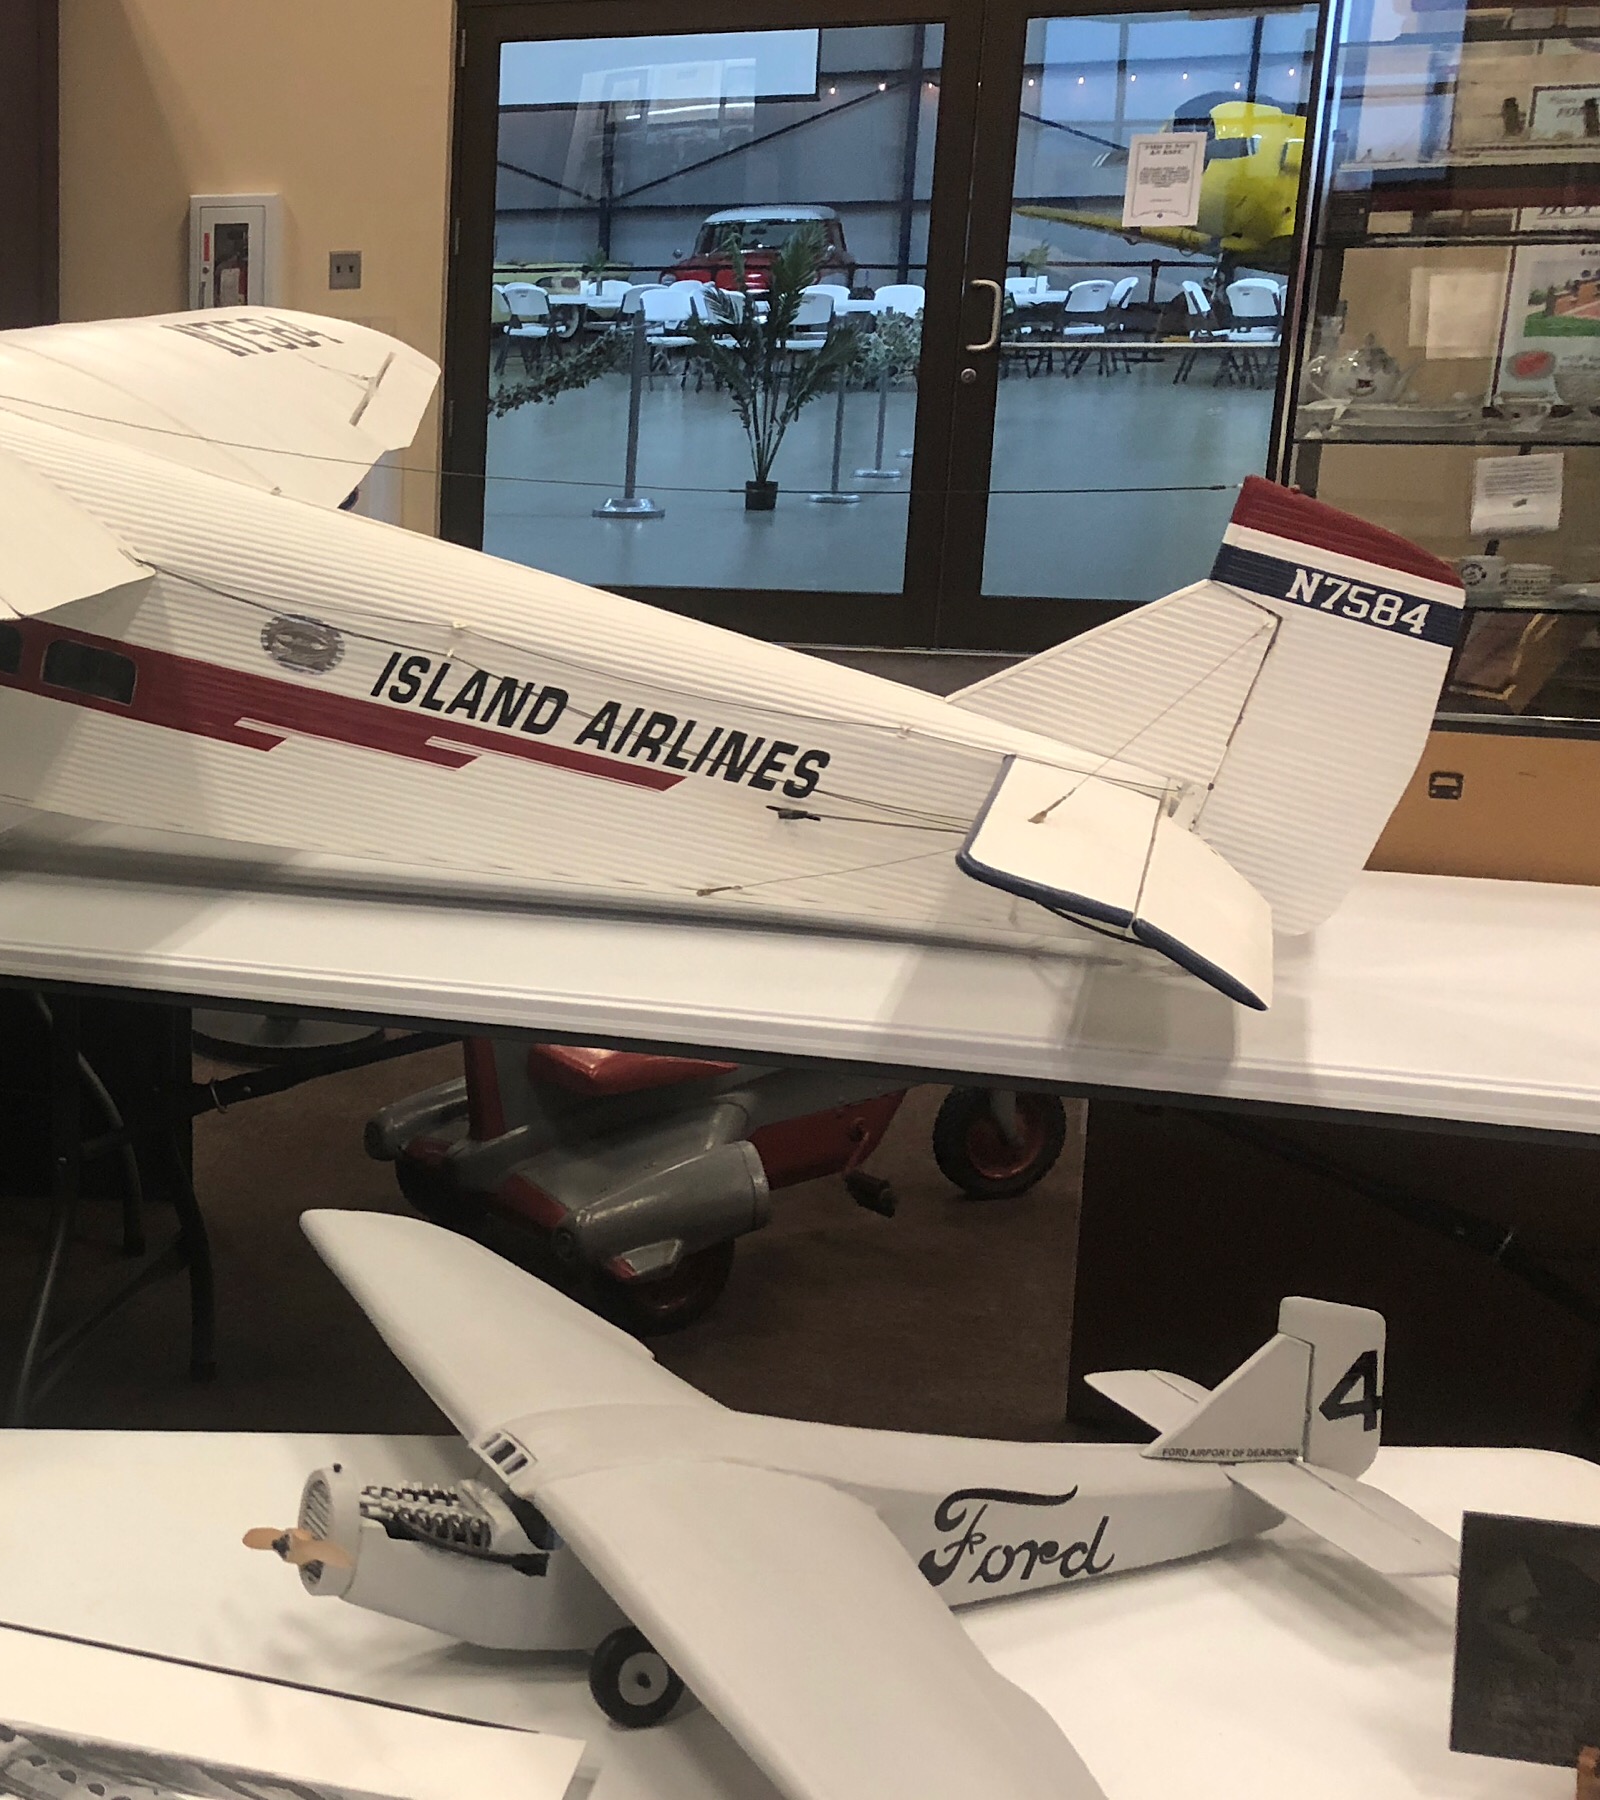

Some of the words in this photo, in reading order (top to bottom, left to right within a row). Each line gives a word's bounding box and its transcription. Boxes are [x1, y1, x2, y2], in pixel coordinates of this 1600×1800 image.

[160, 316, 344, 357] N7584
[1285, 569, 1431, 634] N7584
[370, 652, 570, 735] ISLAND
[574, 700, 831, 798] AIRLINES
[1319, 1349, 1383, 1432] 4
[1162, 1448, 1189, 1458] FORD
[1190, 1448, 1230, 1458] AIRPORT
[1232, 1448, 1245, 1458] OF
[918, 1484, 1115, 1587] Ford
